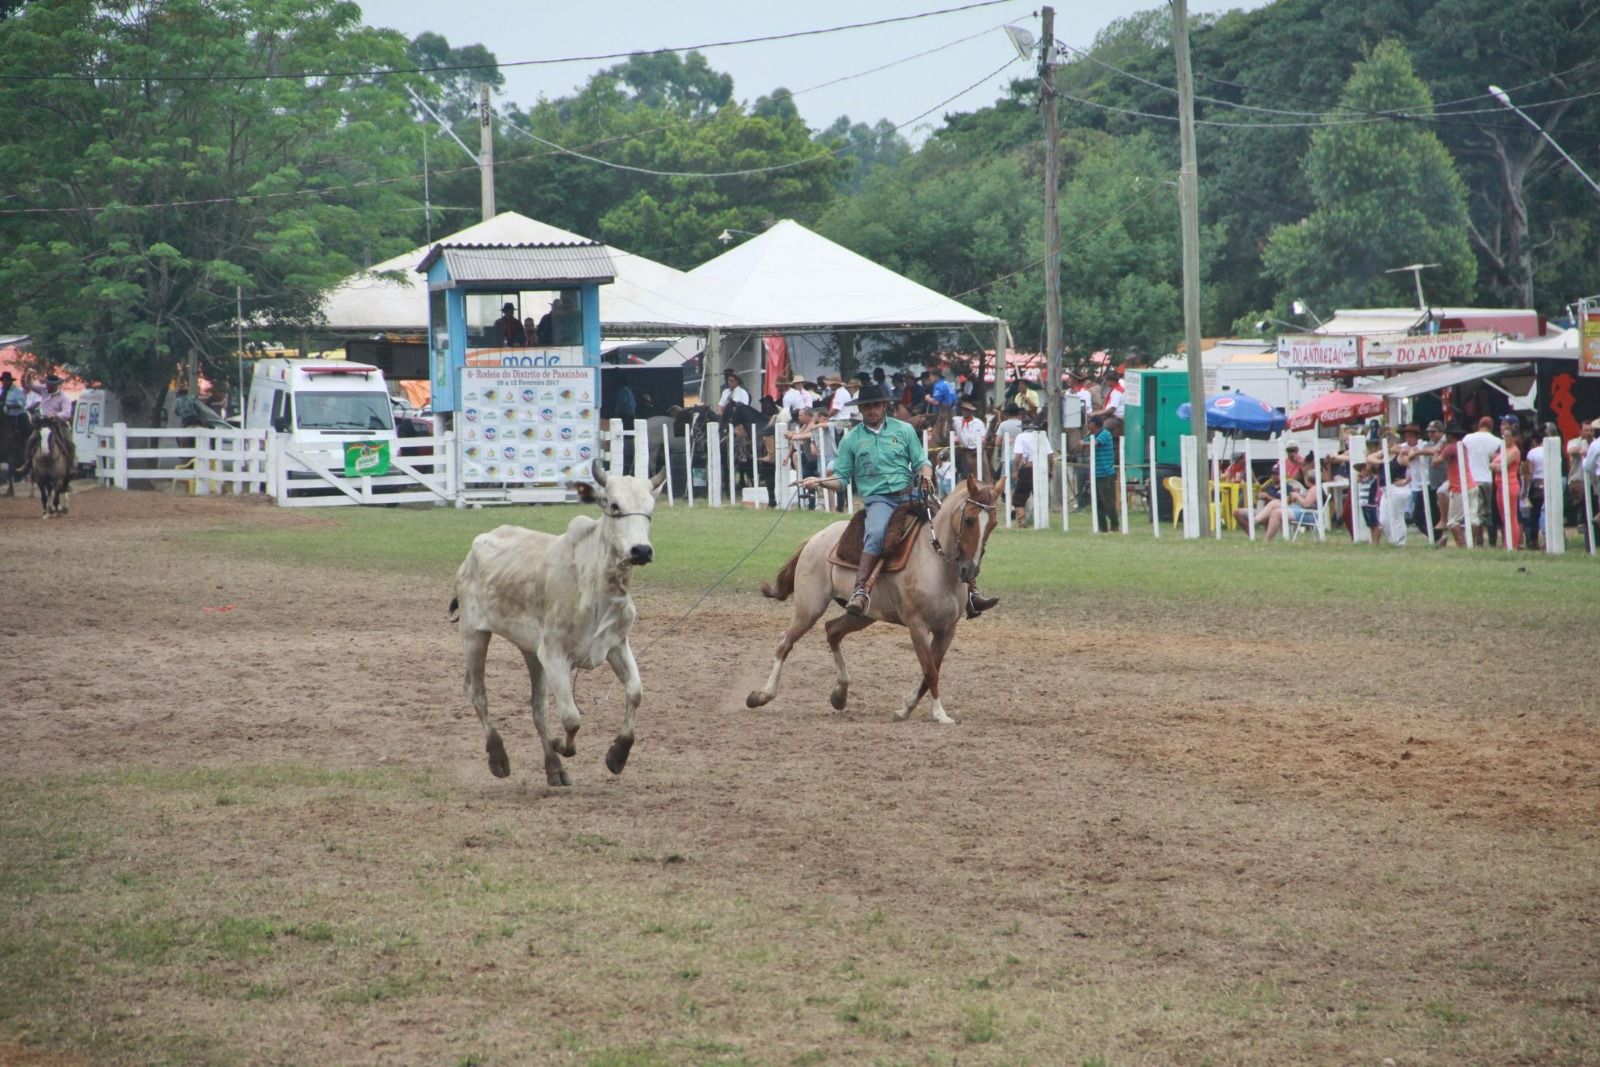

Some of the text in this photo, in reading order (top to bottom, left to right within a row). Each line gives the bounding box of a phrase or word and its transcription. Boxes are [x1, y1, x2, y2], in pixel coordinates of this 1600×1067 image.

[1293, 344, 1343, 363] DO ANDREZÃO
[1397, 341, 1492, 362] DO ANDREZÃO
[476, 370, 500, 378] Rodeio
[502, 370, 511, 378] do
[513, 370, 541, 378] Distrito
[543, 370, 550, 378] de
[553, 370, 588, 378] Passinhos
[1321, 406, 1353, 421] Coca-Cola
